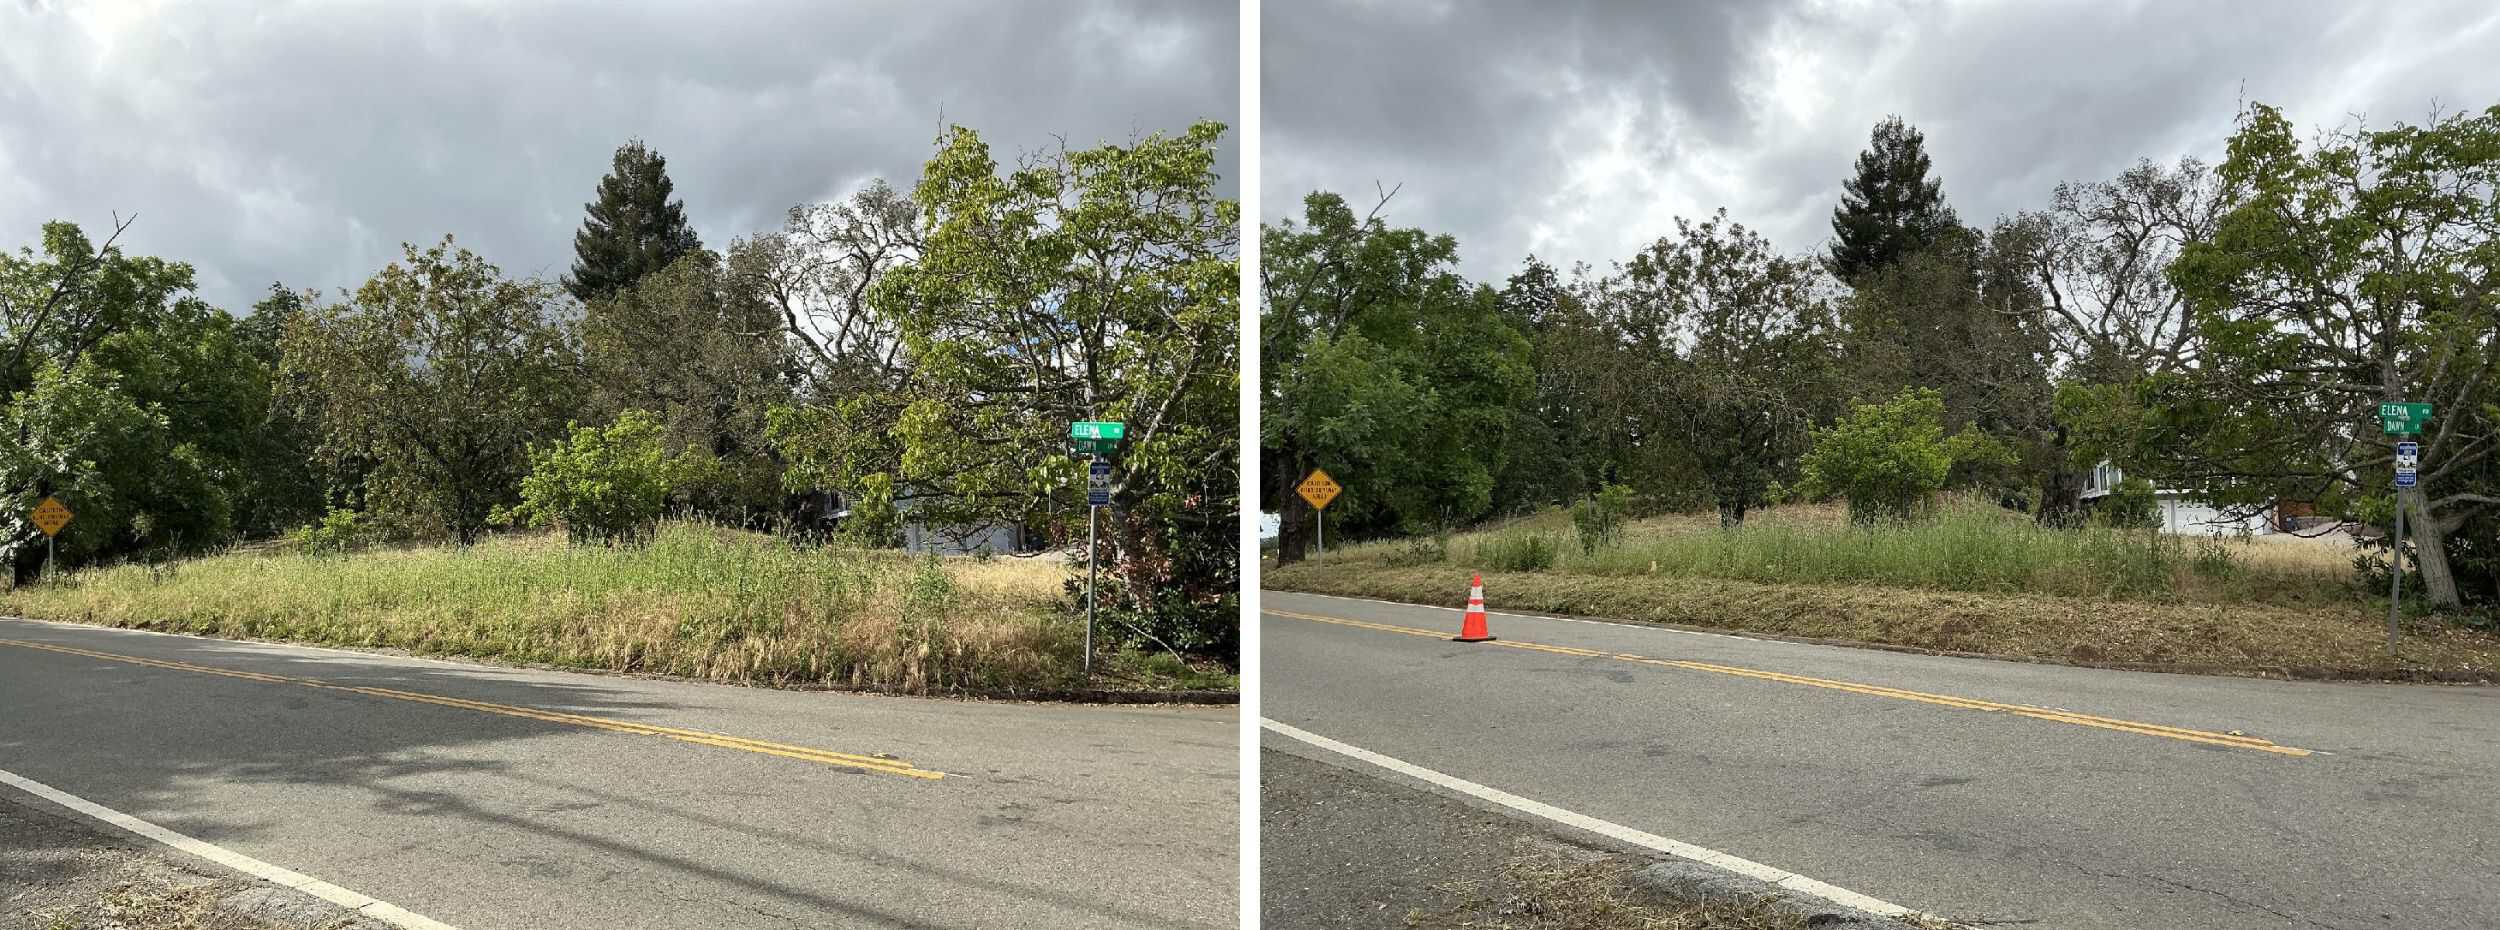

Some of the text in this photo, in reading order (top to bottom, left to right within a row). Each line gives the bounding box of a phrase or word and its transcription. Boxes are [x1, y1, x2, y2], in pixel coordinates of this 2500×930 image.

[2381, 404, 2408, 416] ELENA
[1074, 424, 1100, 437] ELENA
[2387, 420, 2405, 432] DAWN
